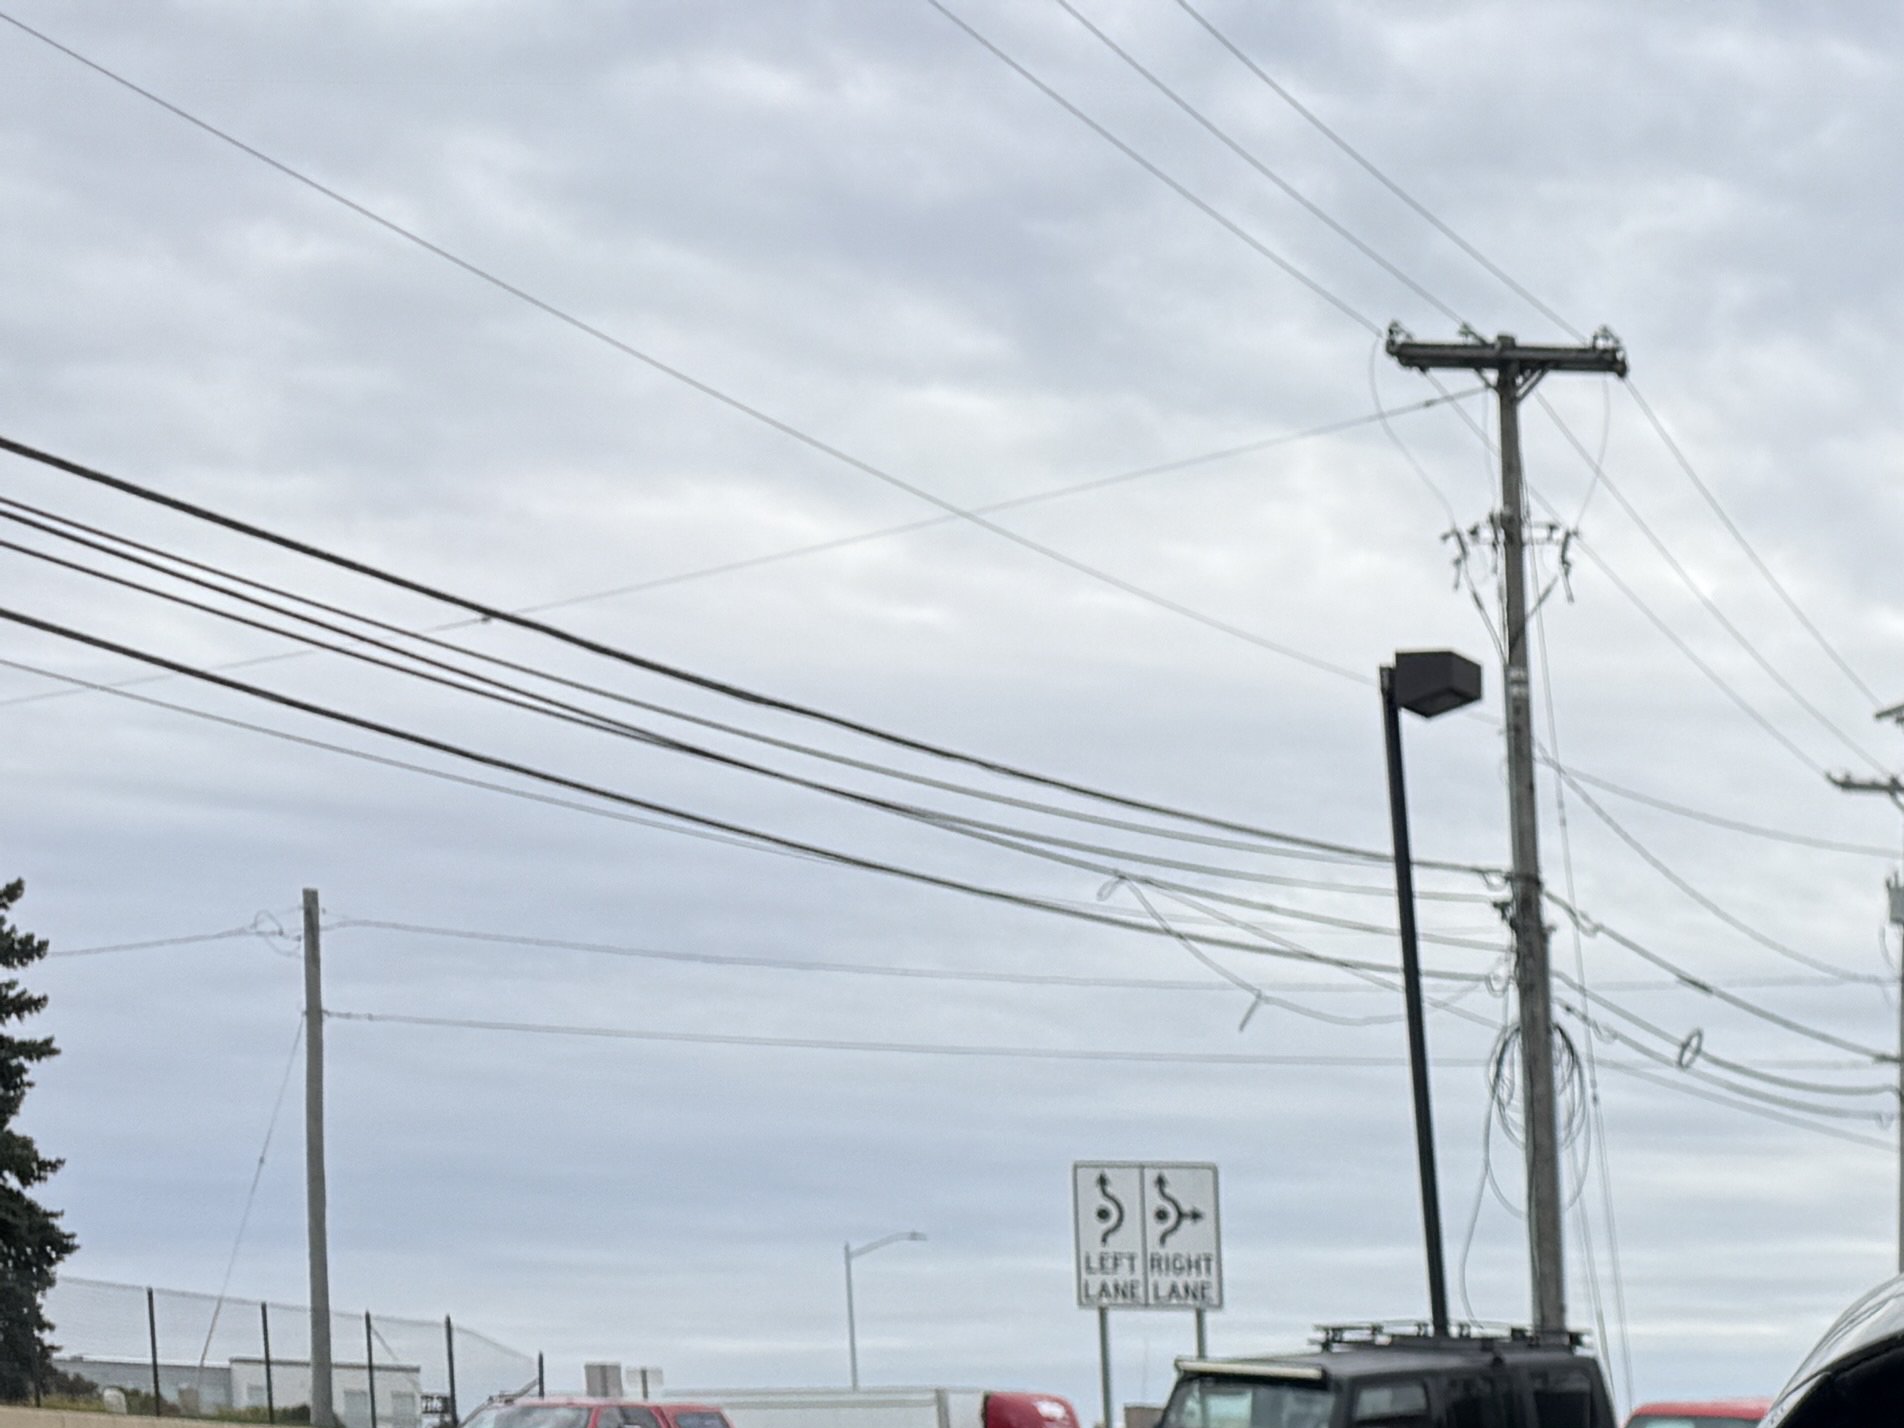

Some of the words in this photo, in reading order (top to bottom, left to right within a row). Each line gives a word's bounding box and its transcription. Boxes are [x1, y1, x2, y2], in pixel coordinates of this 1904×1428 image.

[1085, 1251, 1137, 1275] LEFT
[1150, 1252, 1213, 1276] RIGHT
[1084, 1279, 1140, 1300] LANE
[1152, 1280, 1213, 1301] LANE
